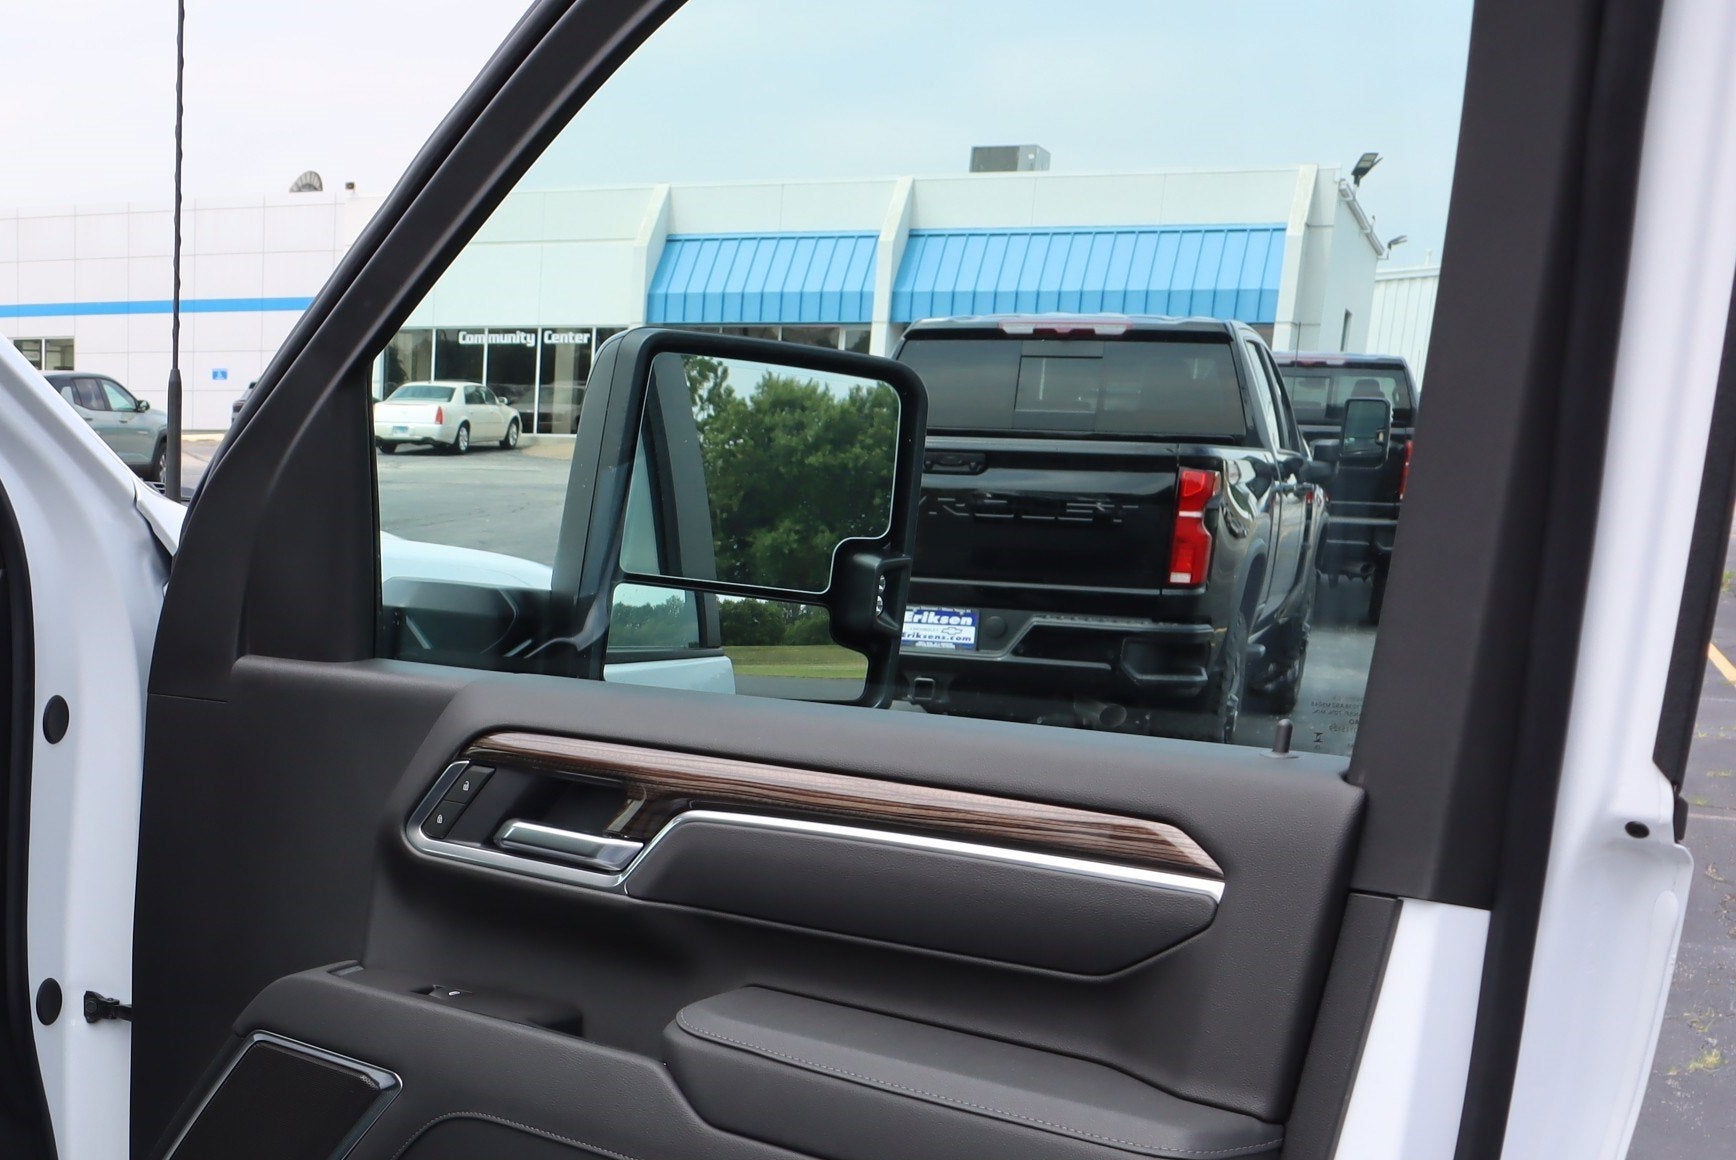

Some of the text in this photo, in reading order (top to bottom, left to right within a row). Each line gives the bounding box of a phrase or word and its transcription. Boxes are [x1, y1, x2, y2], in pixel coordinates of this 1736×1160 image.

[458, 330, 591, 347] Community Center
[904, 610, 973, 626] Eriksen
